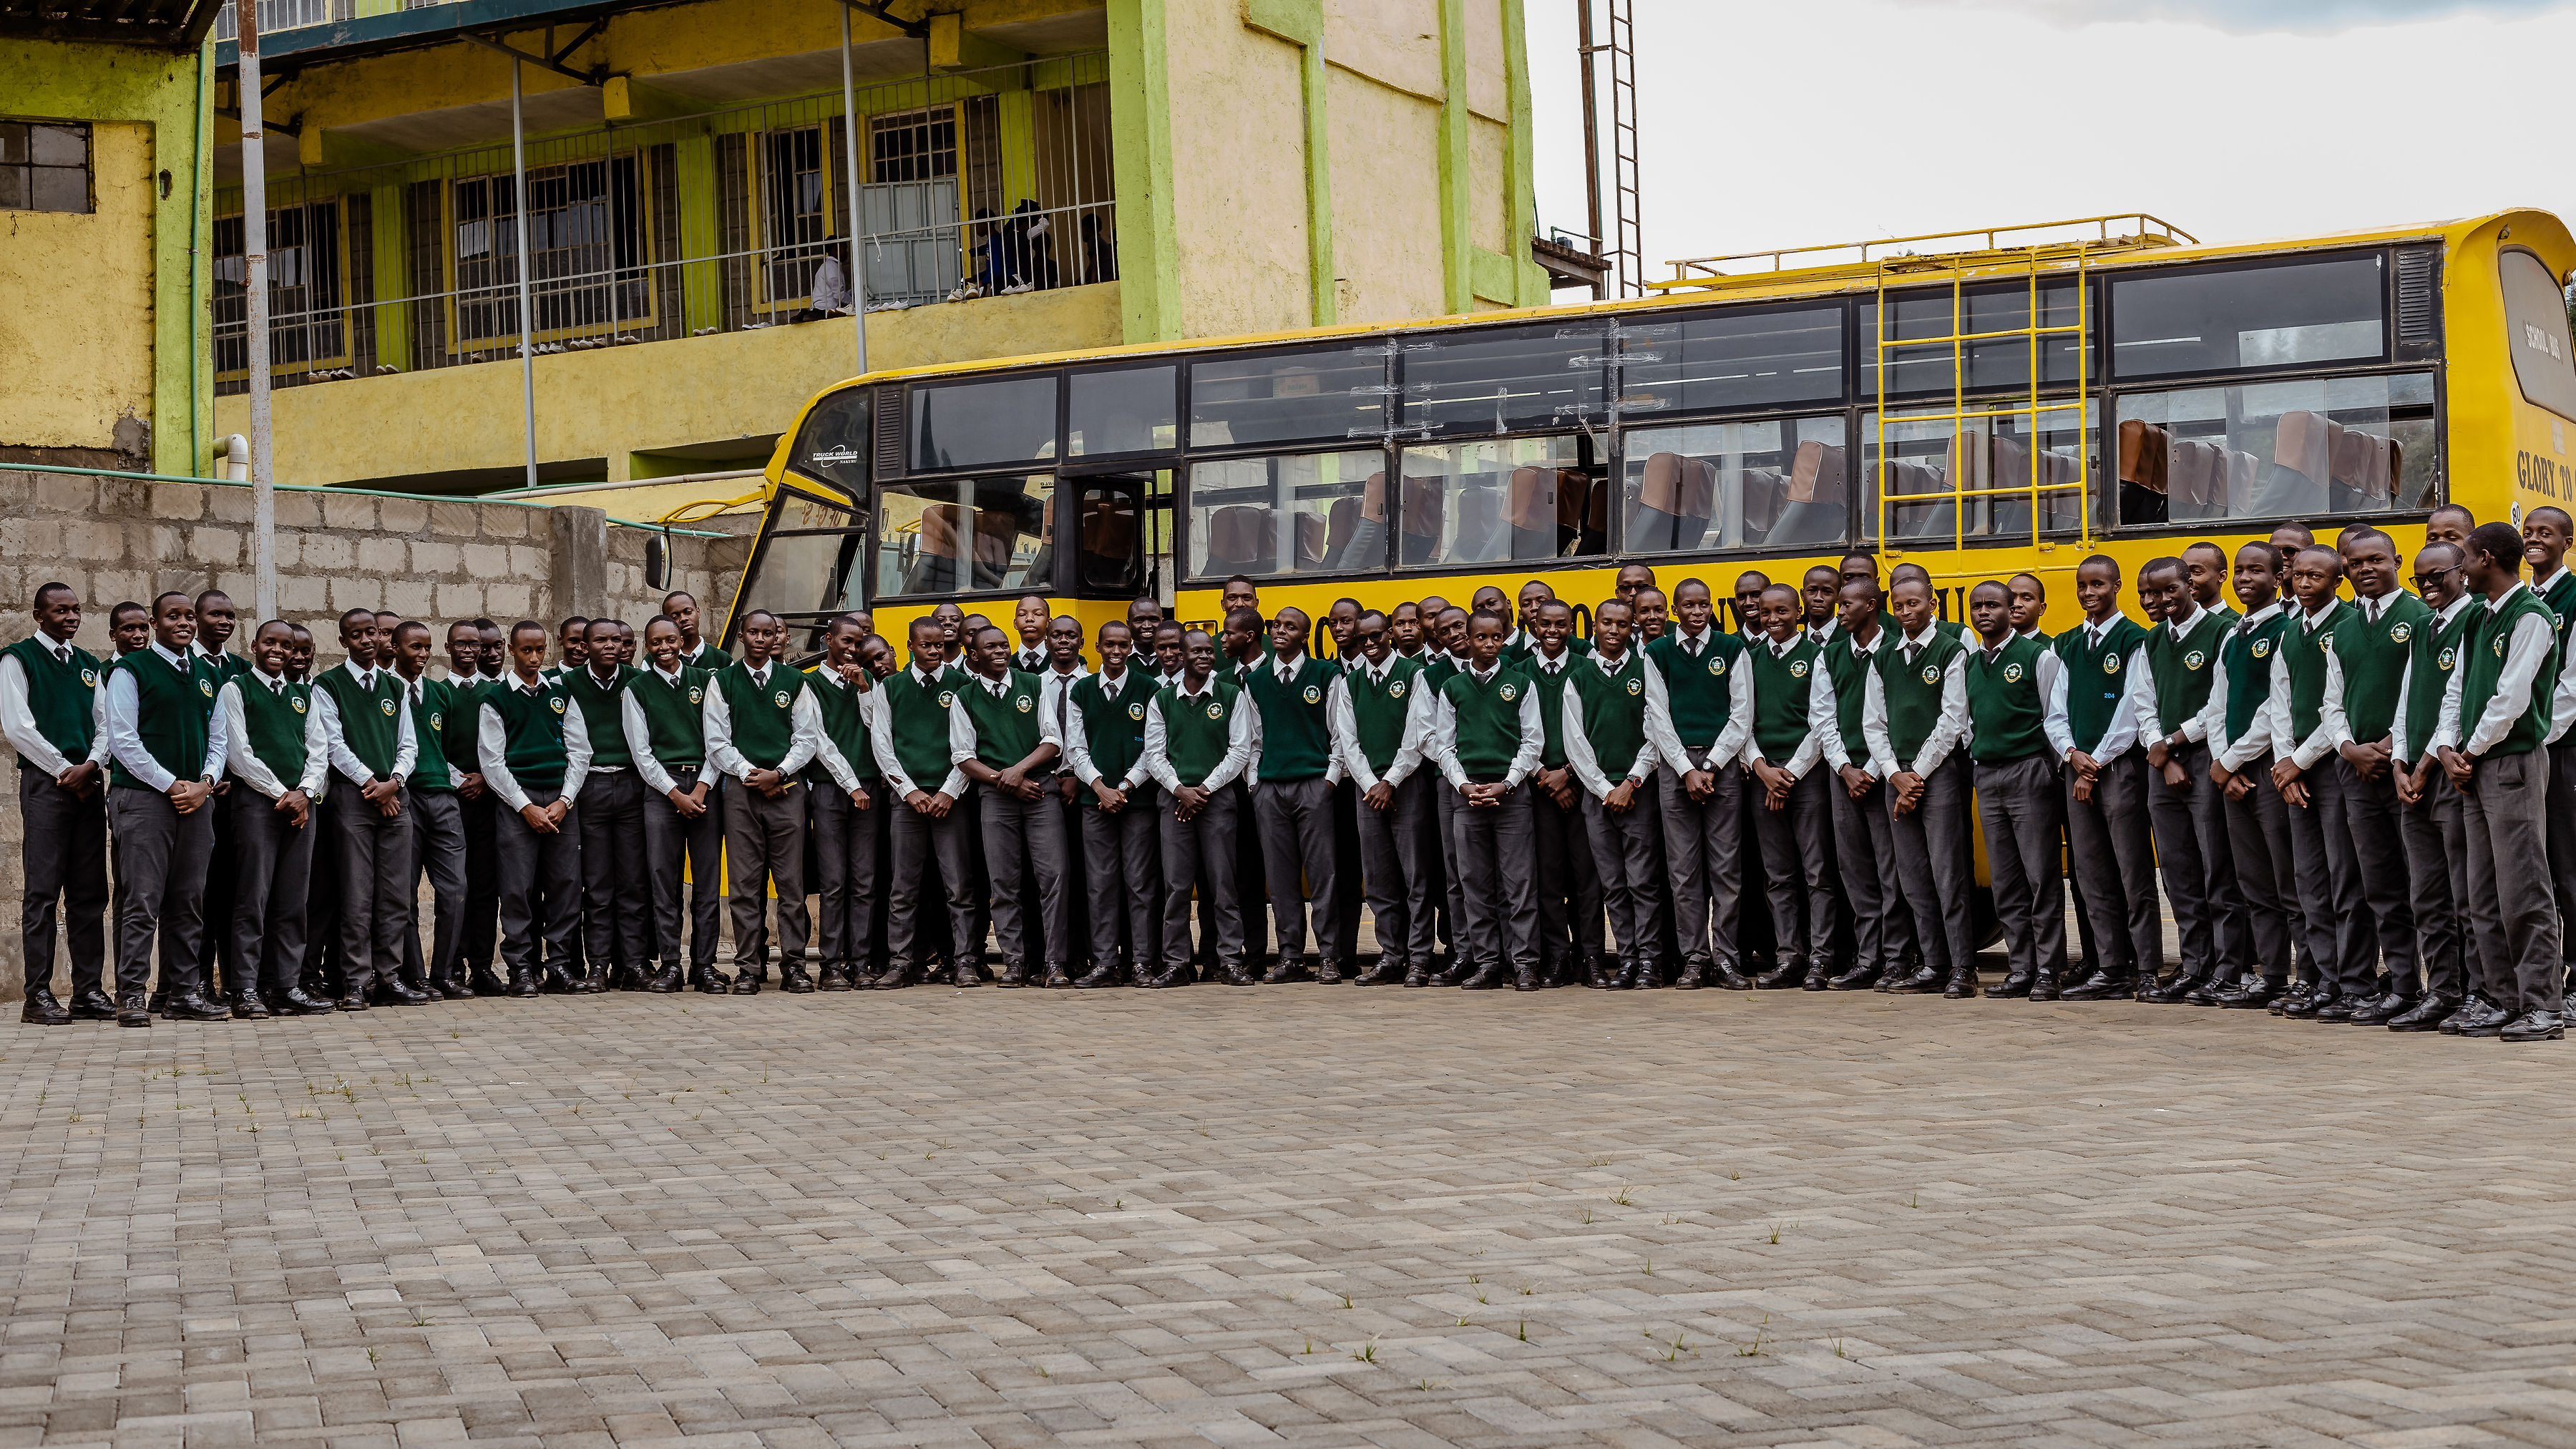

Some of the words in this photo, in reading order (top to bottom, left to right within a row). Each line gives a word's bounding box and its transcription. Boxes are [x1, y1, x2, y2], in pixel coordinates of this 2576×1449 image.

[2525, 323, 2549, 353] SCHOOL
[2549, 333, 2560, 361] BUS
[2517, 449, 2556, 499] GLORY
[2560, 464, 2572, 502] TO
[2512, 504, 2521, 525] 80
